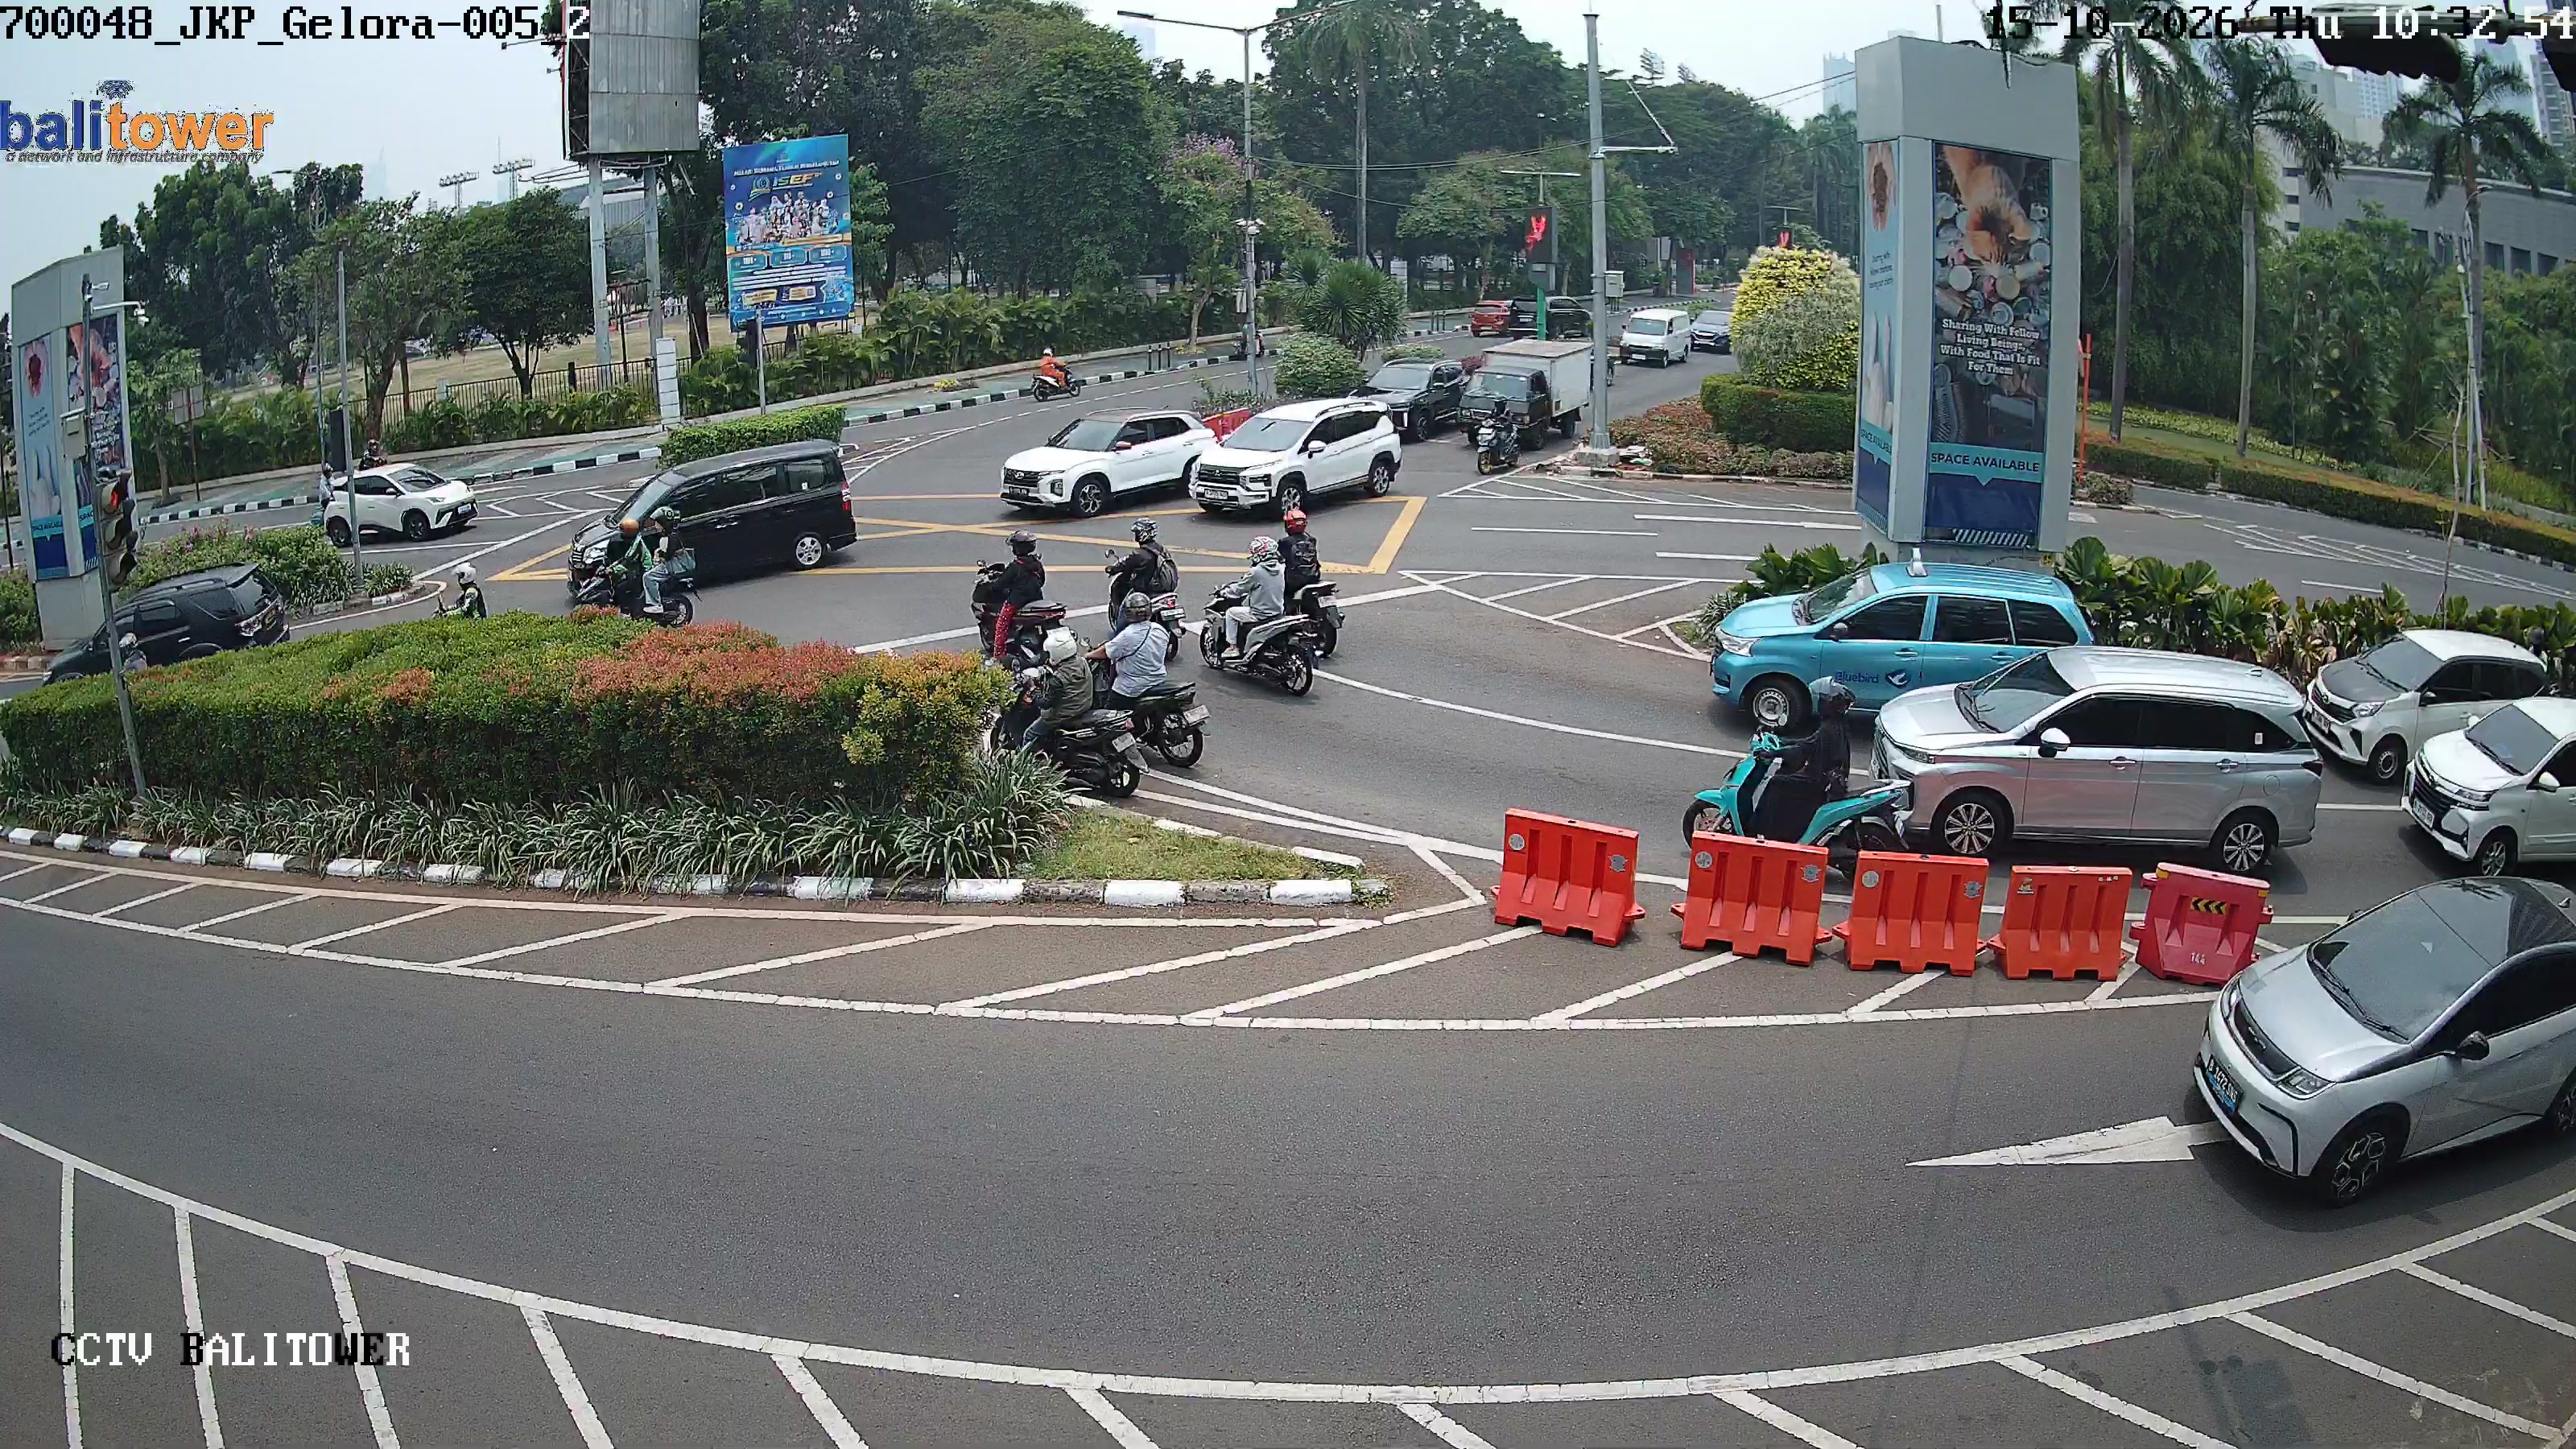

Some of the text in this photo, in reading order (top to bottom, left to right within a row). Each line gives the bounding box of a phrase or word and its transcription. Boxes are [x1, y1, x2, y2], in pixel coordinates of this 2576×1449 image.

[1942, 319, 2040, 339] Sharing With Fellow
[1956, 333, 1989, 348] Living
[1940, 344, 1964, 357] With
[1967, 347, 1990, 359] Food
[1992, 350, 2015, 363] That
[2027, 355, 2041, 365] Fit
[1967, 361, 2014, 375] For Them
[1930, 453, 2040, 472] SPACE AVAILABLE
[1835, 670, 1880, 683] Bluebird
